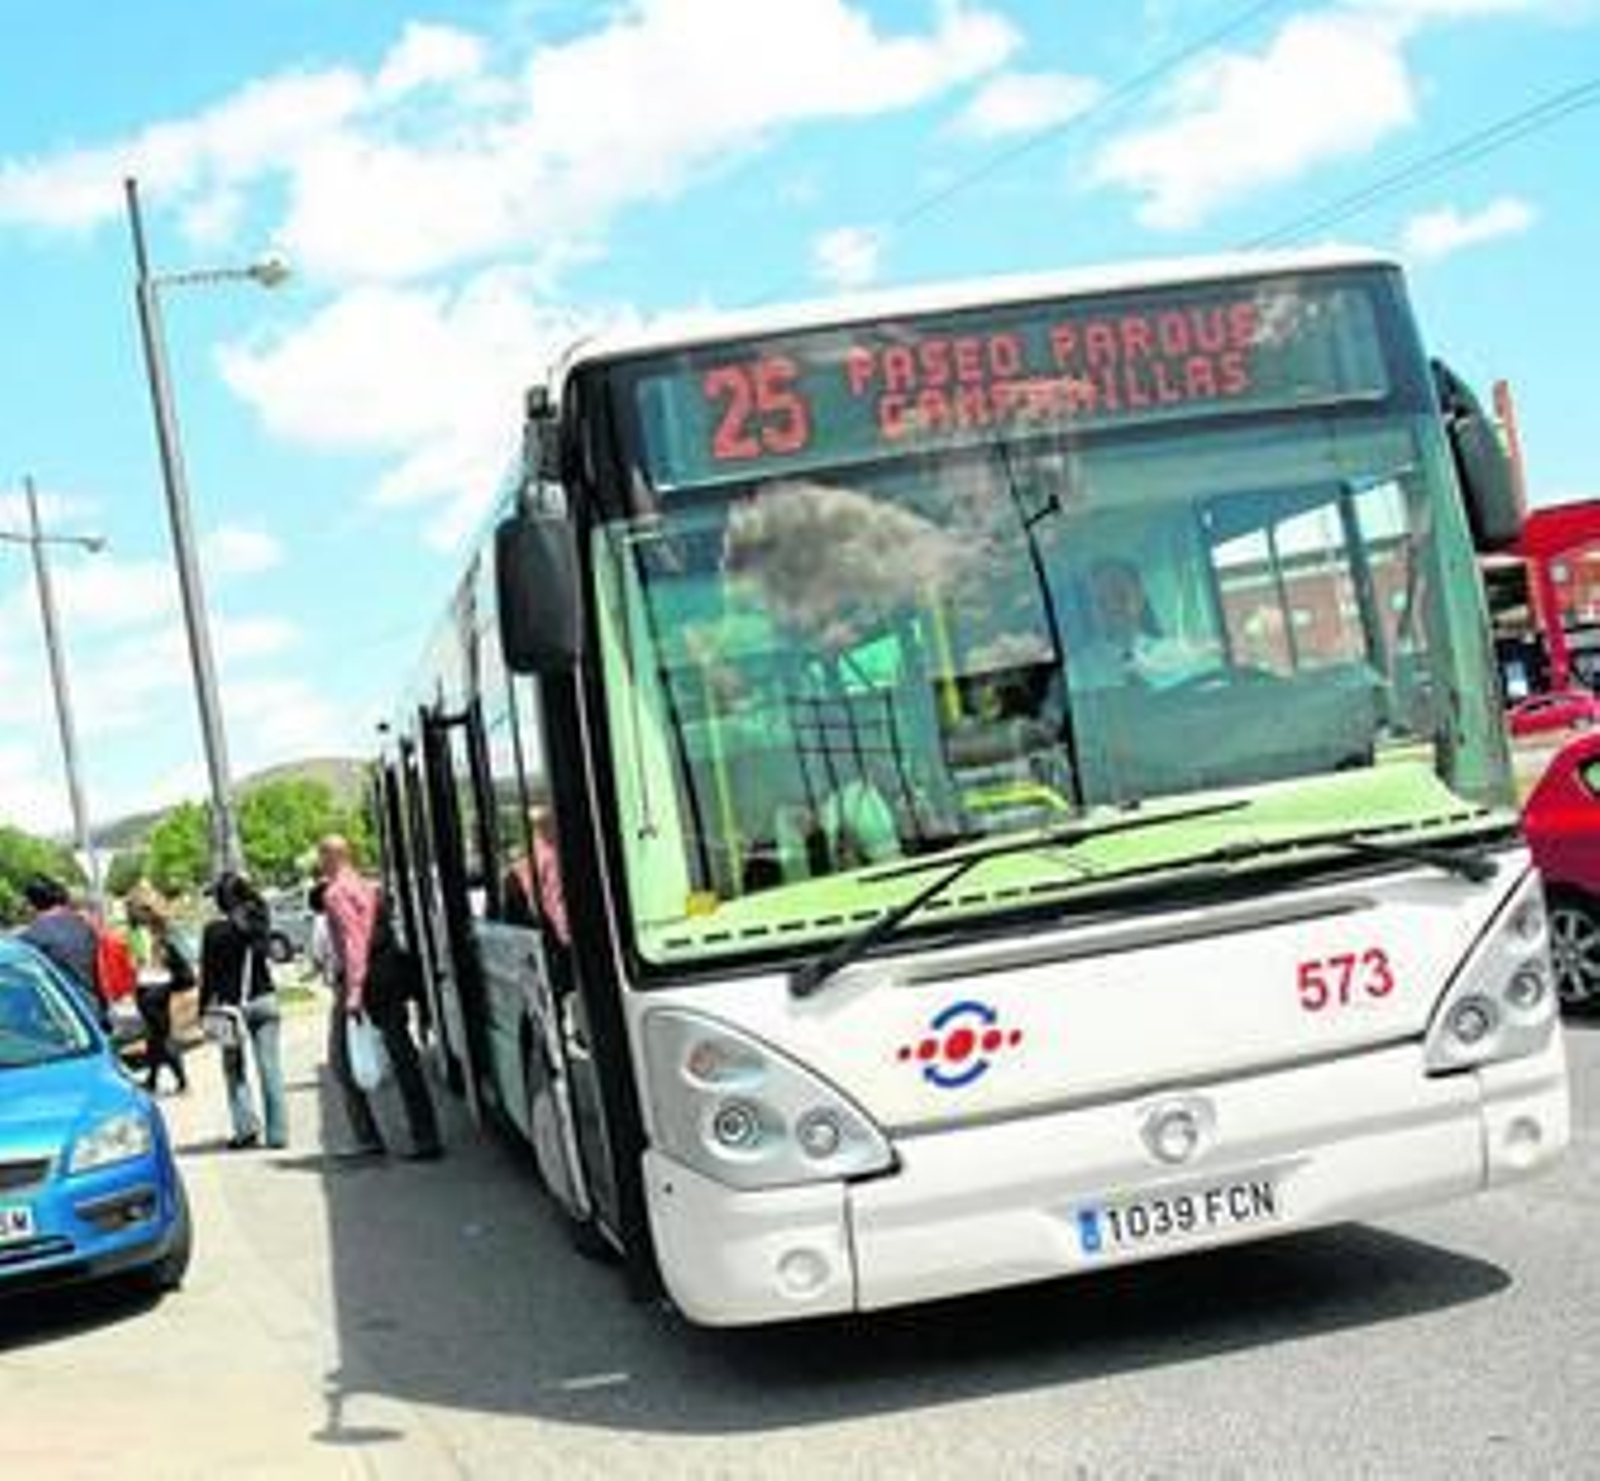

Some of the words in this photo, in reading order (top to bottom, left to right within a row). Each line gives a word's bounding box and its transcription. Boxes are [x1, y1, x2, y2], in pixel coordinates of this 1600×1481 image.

[848, 334, 1020, 398] PASEO
[1050, 303, 1257, 368] PARQUE
[704, 358, 808, 459] 25
[1296, 948, 1394, 1012] 573
[1107, 1196, 1195, 1241] 1039
[1205, 1182, 1274, 1221] FCN
